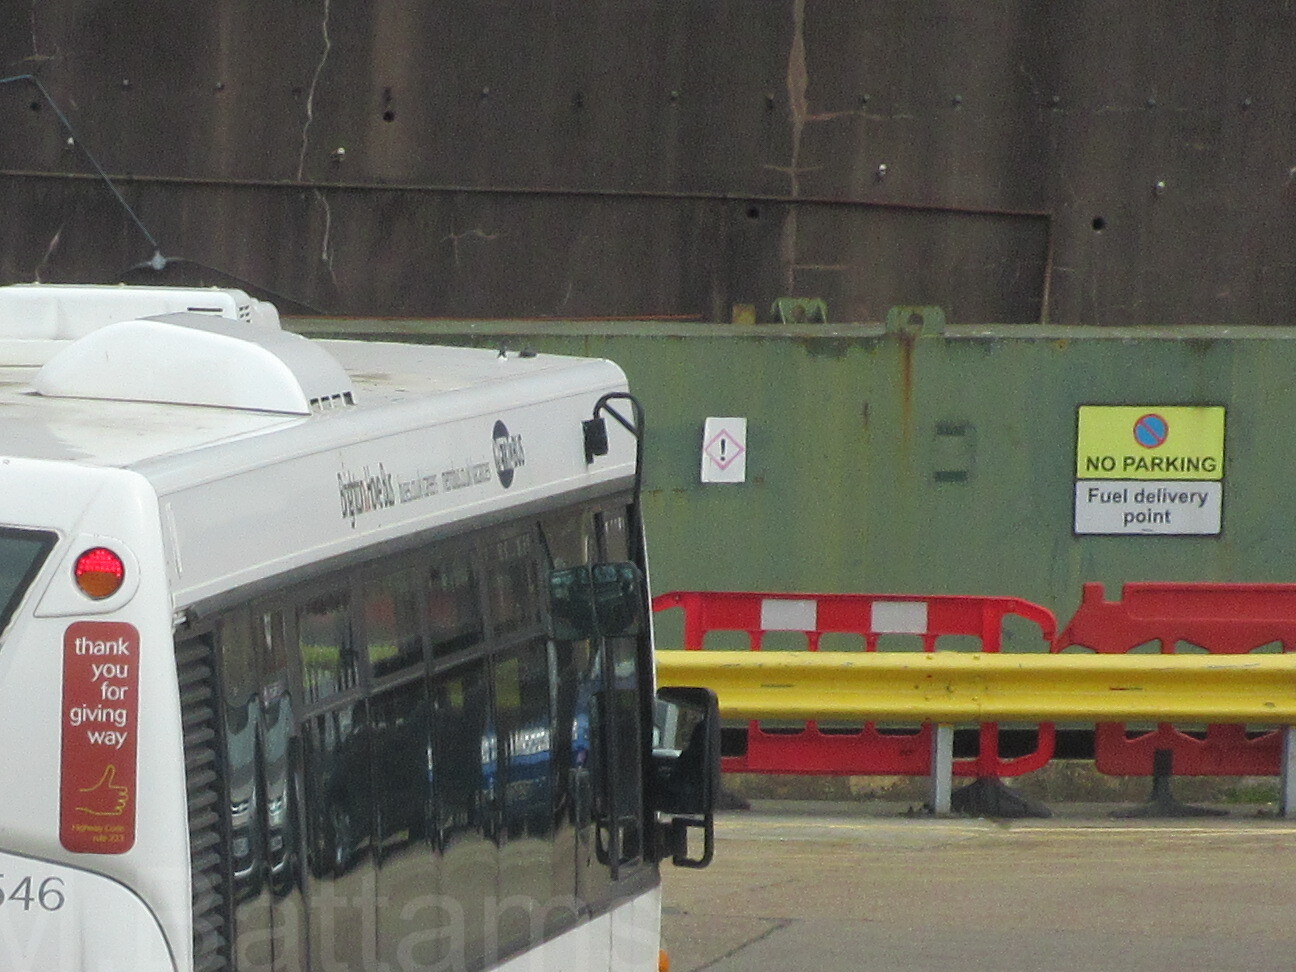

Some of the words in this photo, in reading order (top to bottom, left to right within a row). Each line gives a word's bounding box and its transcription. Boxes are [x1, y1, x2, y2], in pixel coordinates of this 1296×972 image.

[1086, 456, 1116, 472] NO
[1122, 456, 1217, 473] PARKING
[1088, 488, 1128, 503] Fuel
[1134, 488, 1209, 508] delivery
[1124, 508, 1171, 527] point
[75, 637, 130, 655] thank
[92, 662, 129, 682] you
[100, 681, 129, 700] for
[70, 704, 127, 727] giving
[87, 731, 127, 749] way
